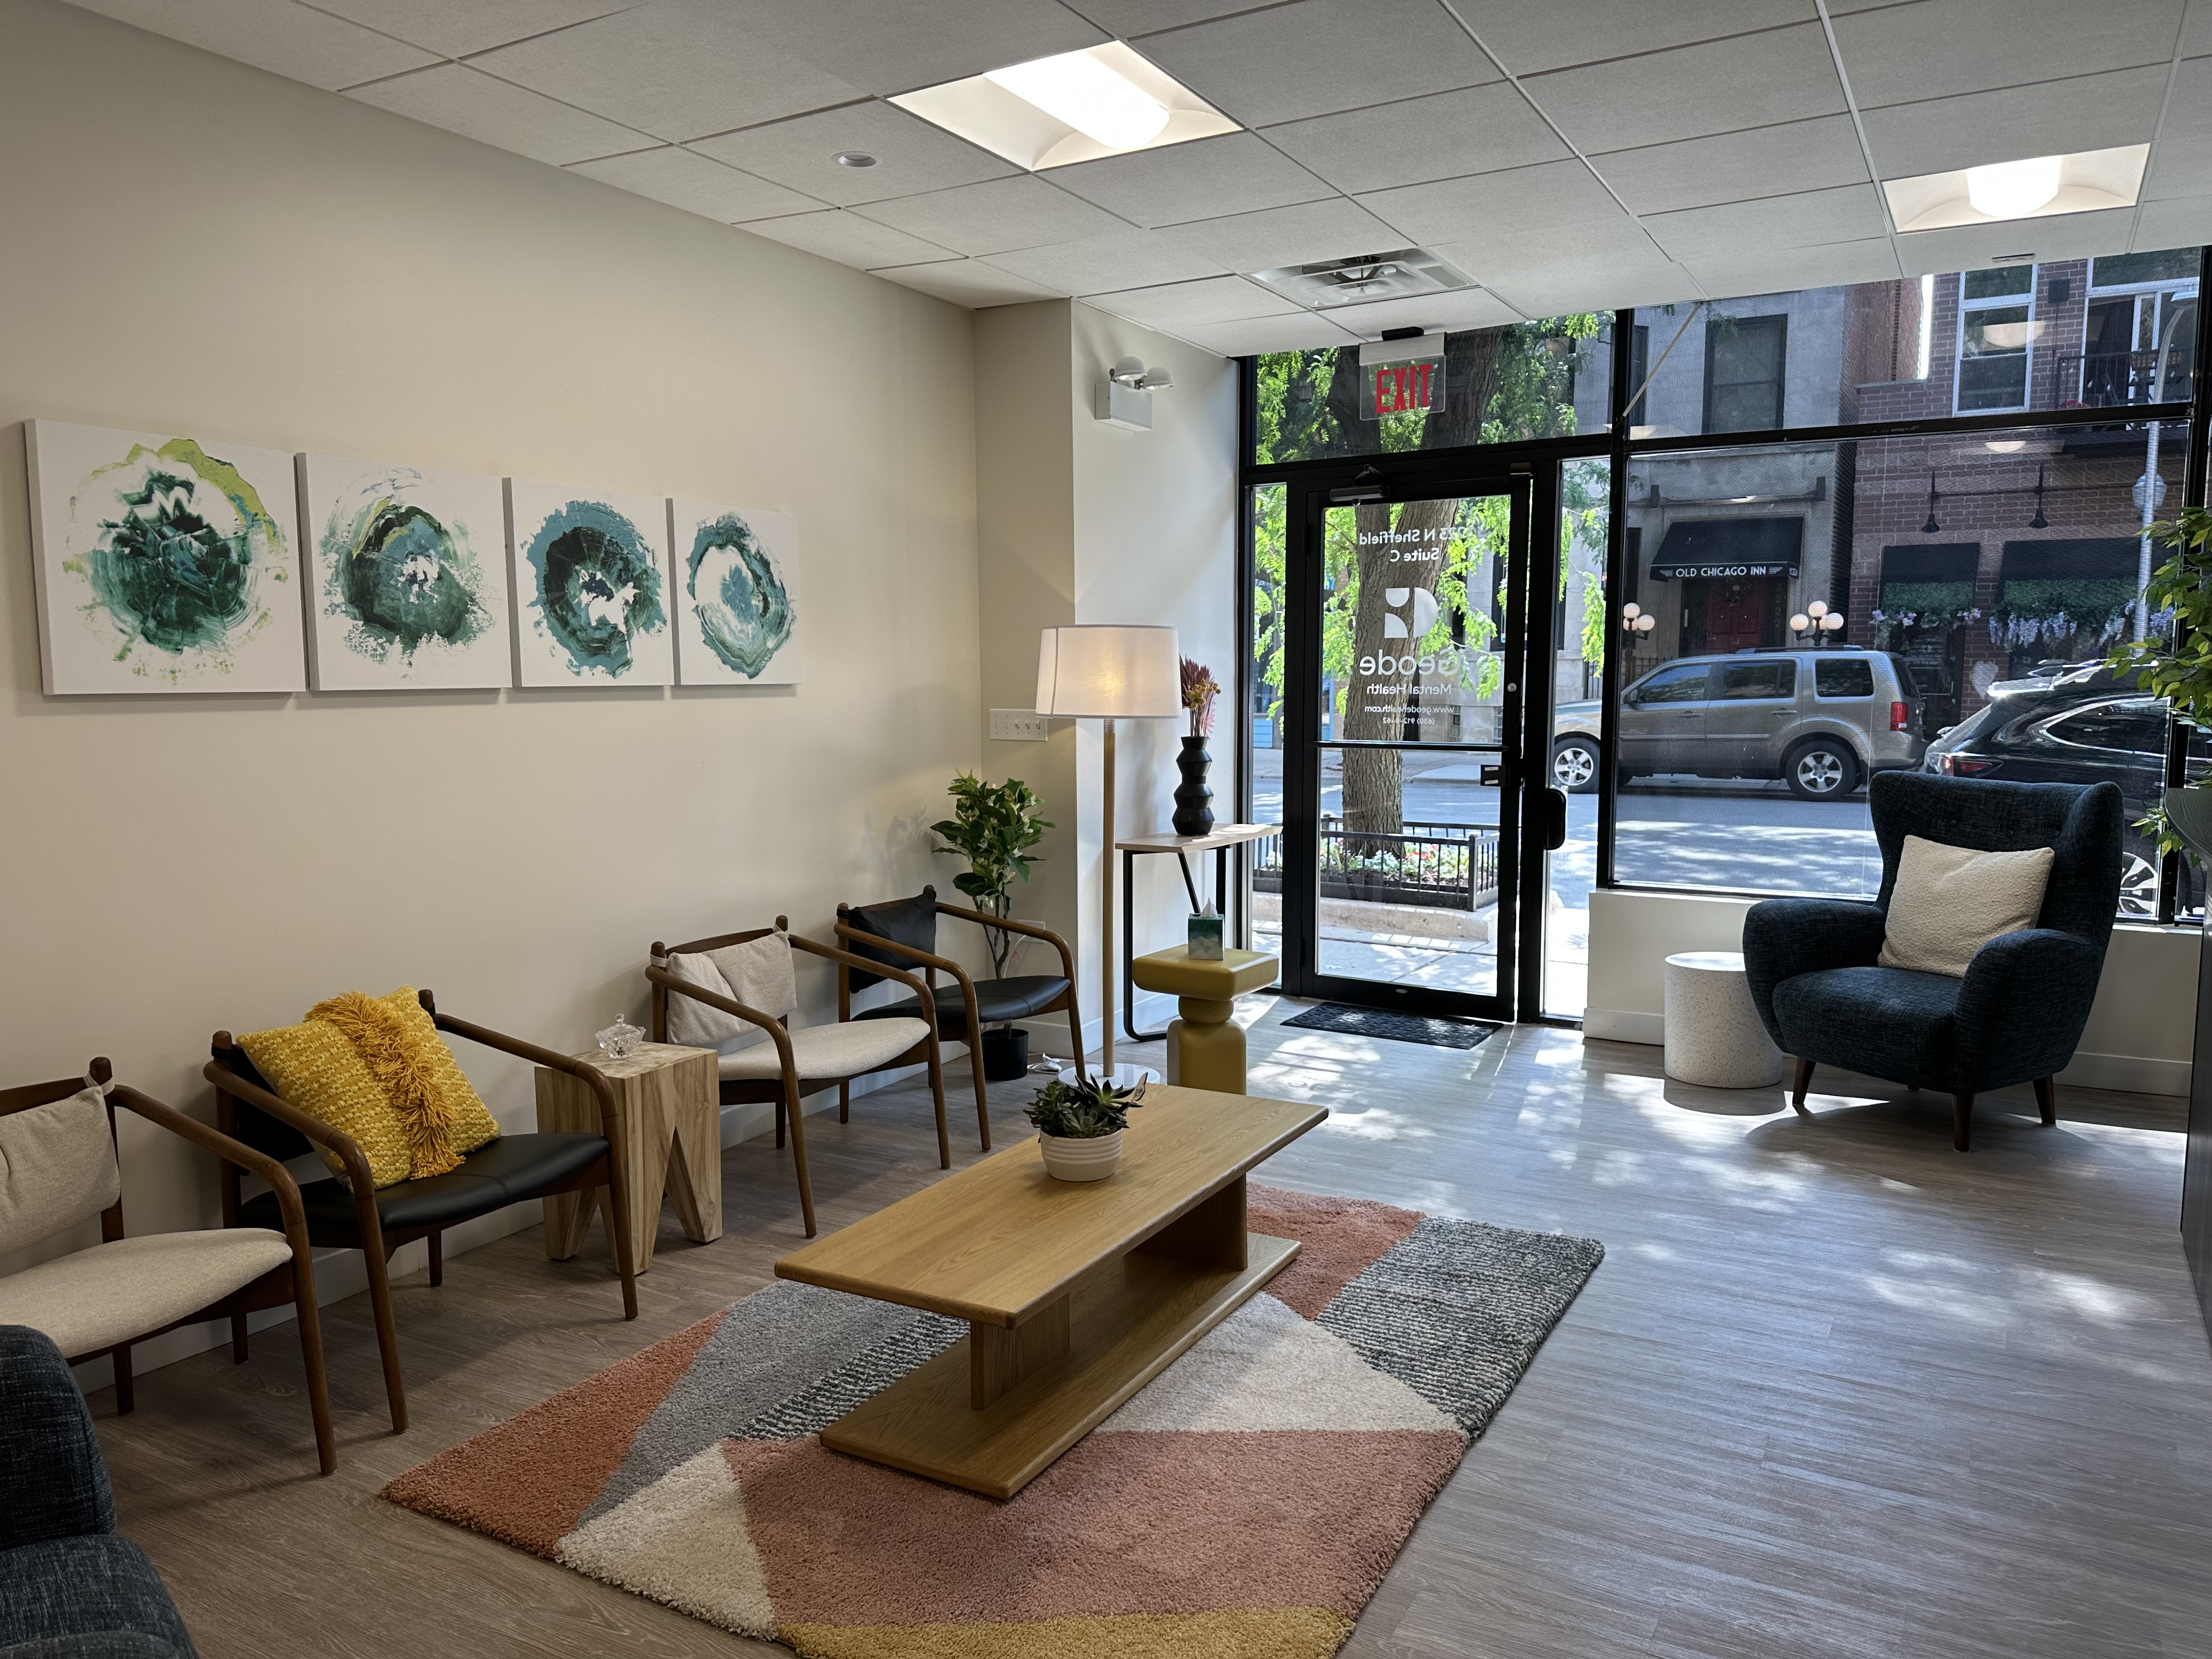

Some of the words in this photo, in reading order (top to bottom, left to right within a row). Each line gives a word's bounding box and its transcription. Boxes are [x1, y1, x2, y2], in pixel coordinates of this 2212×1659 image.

[1376, 364, 1432, 413] EXIT
[1675, 567, 1697, 577] OLD
[1701, 566, 1746, 576] CHICAGO
[1750, 566, 1767, 575] INN
